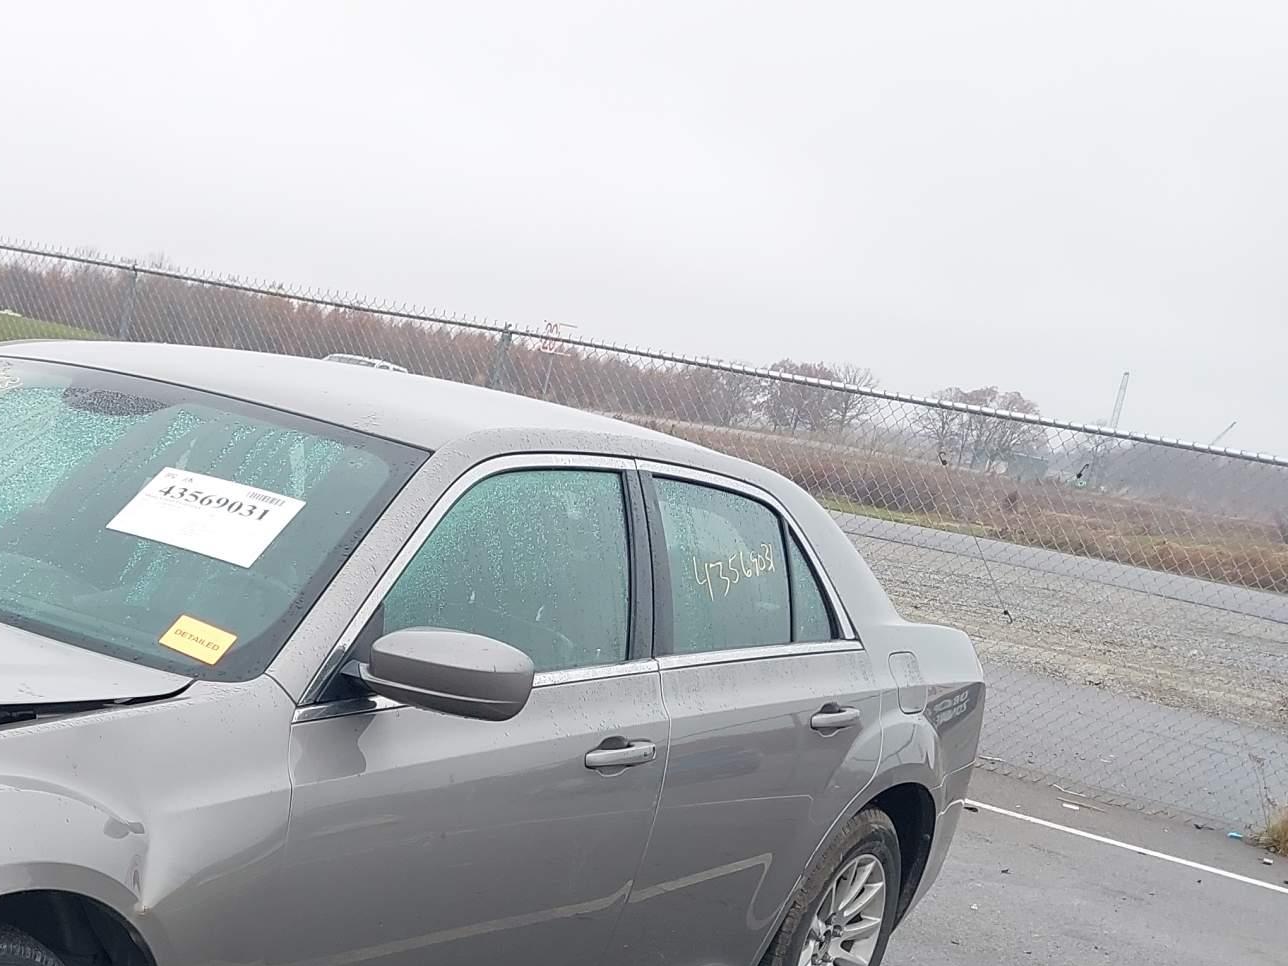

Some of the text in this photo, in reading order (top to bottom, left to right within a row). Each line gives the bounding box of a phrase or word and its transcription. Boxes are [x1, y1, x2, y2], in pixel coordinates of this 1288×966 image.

[158, 484, 271, 521] 43569031
[692, 543, 776, 602] 43569031
[173, 628, 221, 652] DETAILED
